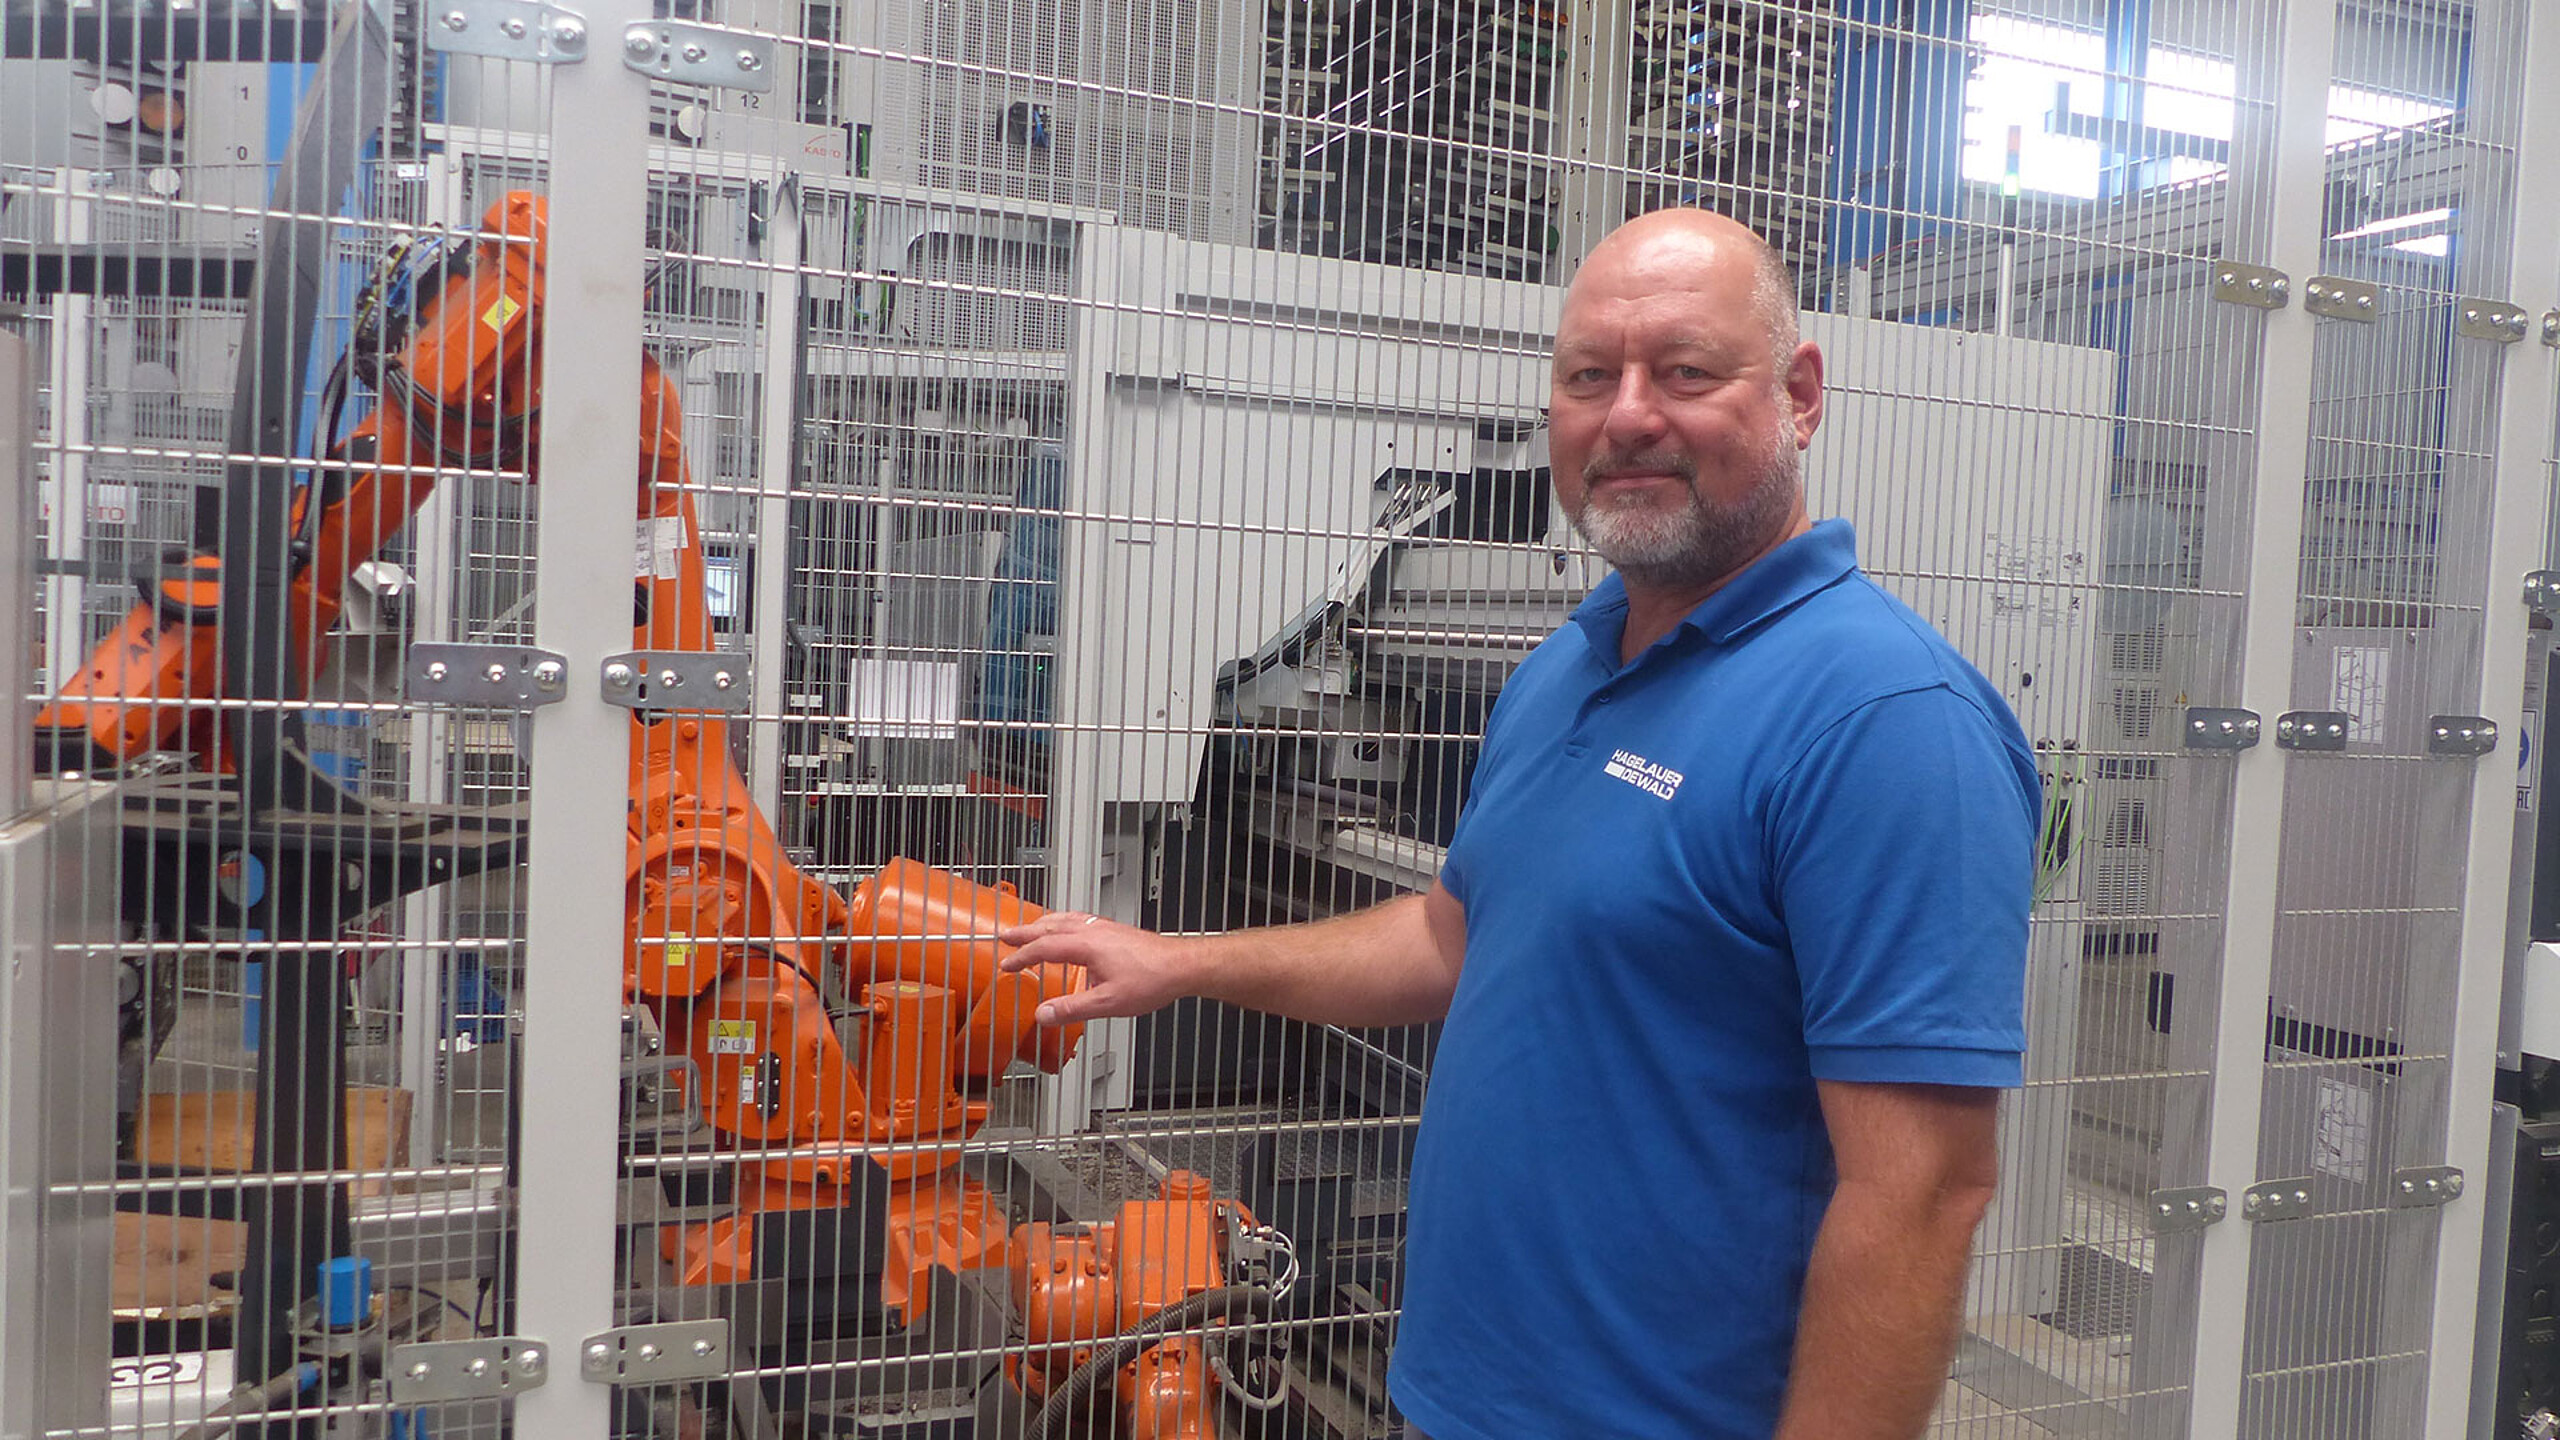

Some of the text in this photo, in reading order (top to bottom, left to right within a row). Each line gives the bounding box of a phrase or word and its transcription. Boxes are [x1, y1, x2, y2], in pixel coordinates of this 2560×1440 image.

[740, 94, 759, 109] 12
[804, 146, 841, 158] KASO
[1611, 748, 1684, 788] HAGELAUER
[1621, 768, 1675, 801] DEWALD
